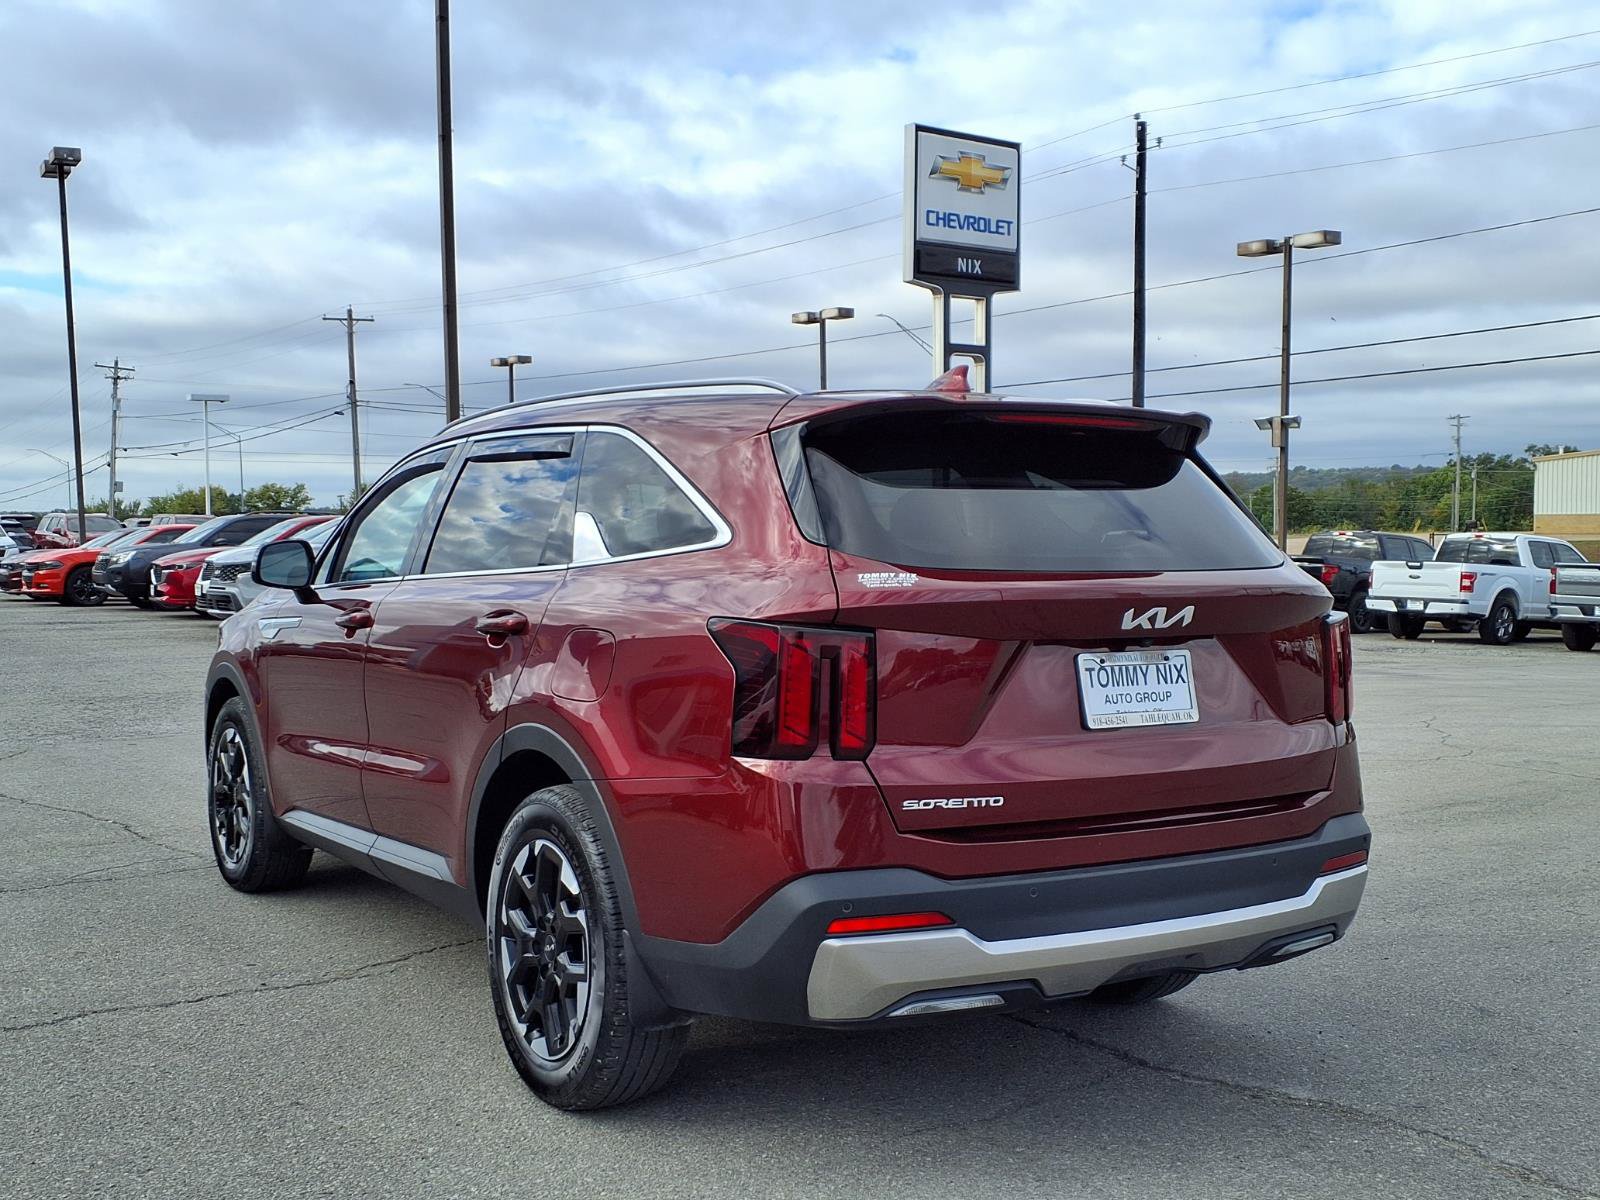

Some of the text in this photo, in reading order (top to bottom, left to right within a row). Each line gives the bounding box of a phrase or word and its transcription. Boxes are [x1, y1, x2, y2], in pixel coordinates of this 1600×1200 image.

[925, 209, 1014, 237] CHEVROLET
[957, 257, 983, 275] NIX
[857, 572, 896, 581] TOMMY
[1121, 605, 1195, 630] KIA
[1084, 663, 1187, 689] TOMMY NIX
[1104, 690, 1172, 705] AUTO GROUP
[901, 796, 1005, 811] SORENTO
